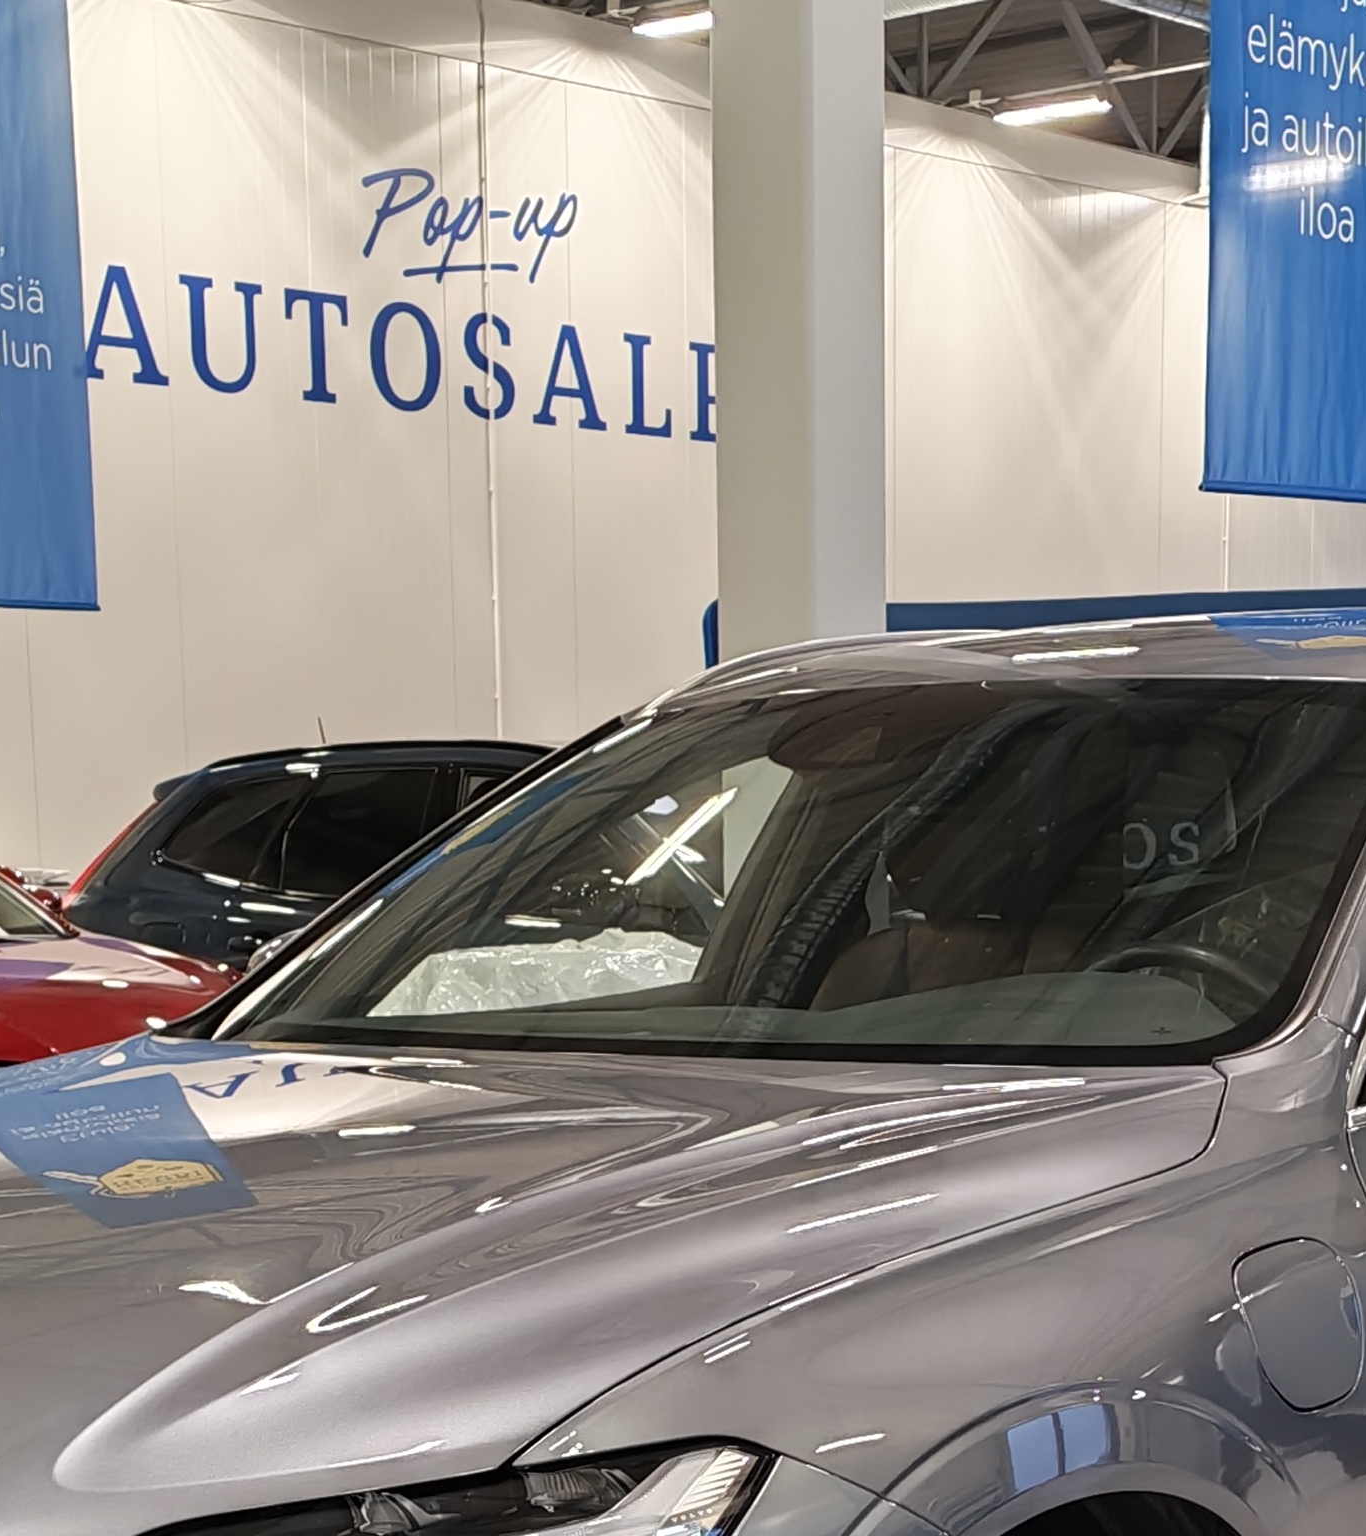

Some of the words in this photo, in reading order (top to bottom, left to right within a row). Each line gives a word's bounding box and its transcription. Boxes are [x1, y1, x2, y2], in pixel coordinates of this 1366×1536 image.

[1241, 91, 1269, 153] ja
[361, 167, 578, 284] Pop-up
[1300, 185, 1355, 244] iloa
